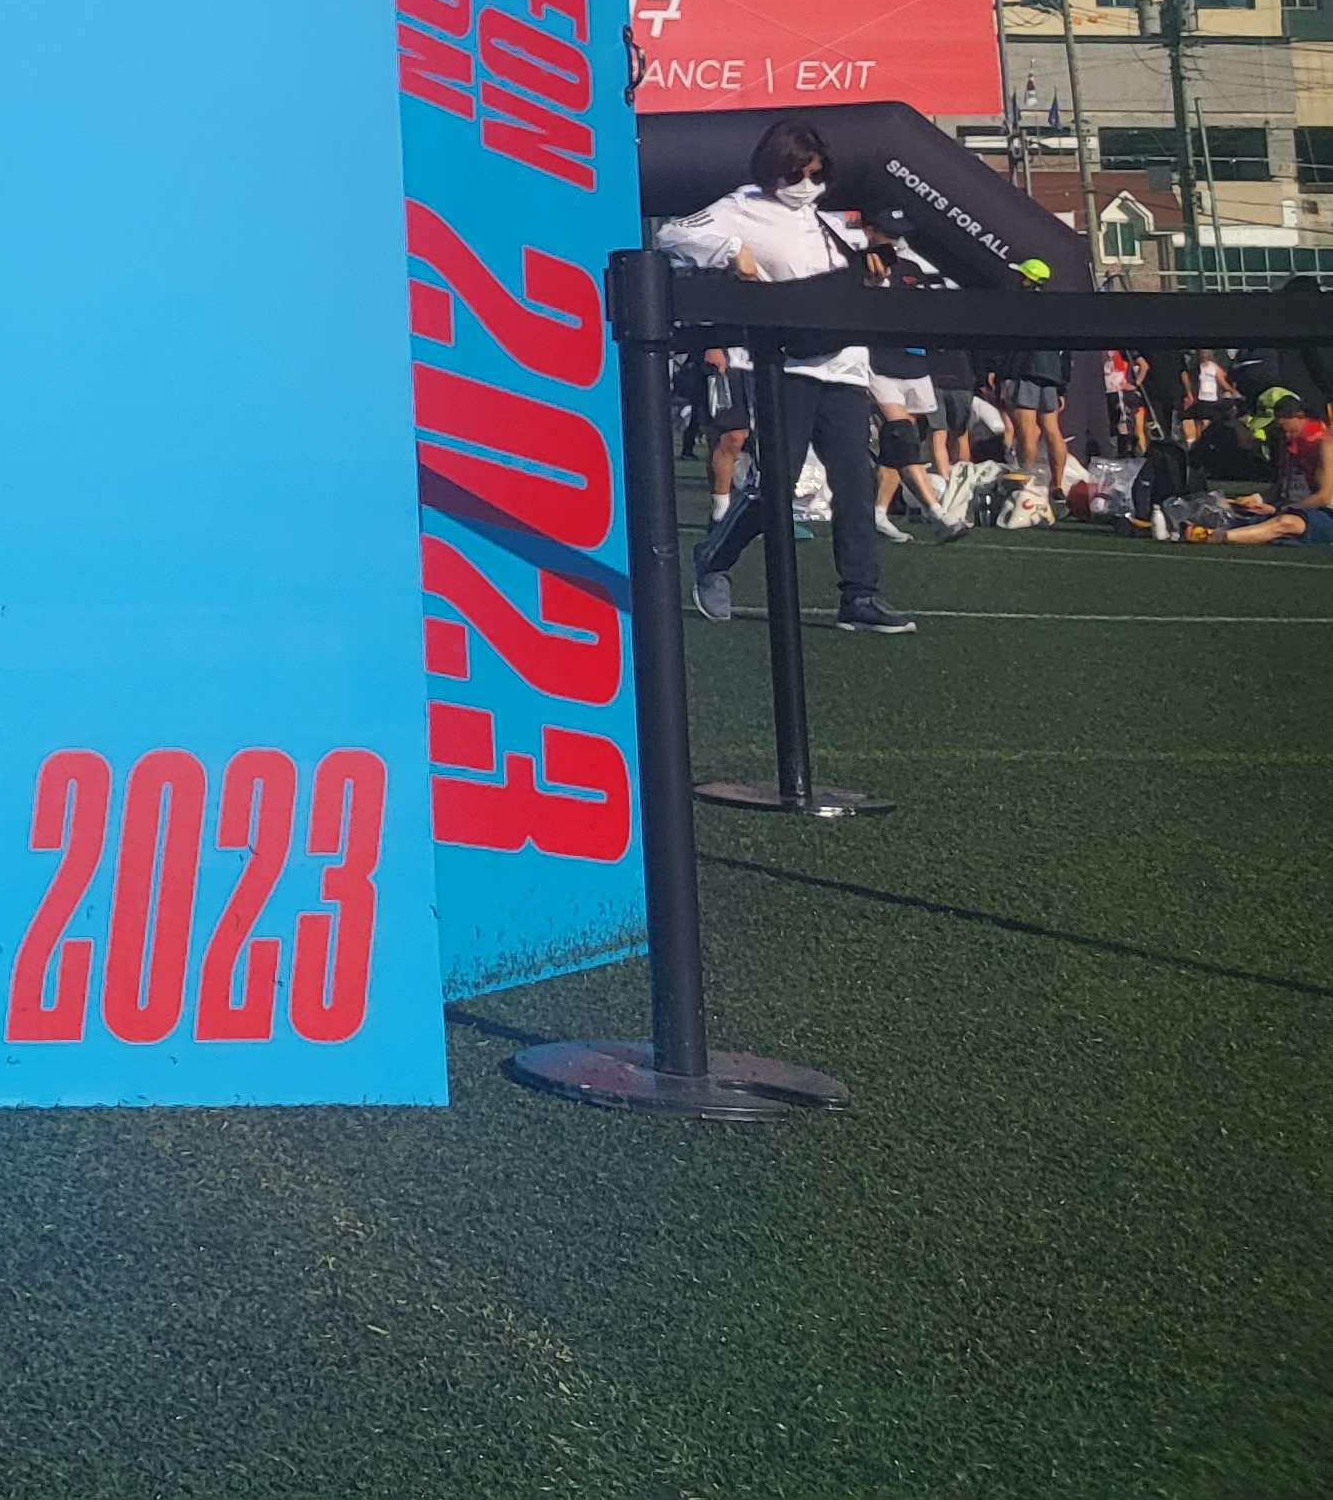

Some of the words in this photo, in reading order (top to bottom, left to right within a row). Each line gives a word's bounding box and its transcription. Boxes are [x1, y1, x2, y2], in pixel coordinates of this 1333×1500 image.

[639, 59, 746, 90] ANCE
[796, 60, 877, 91] EXIT
[885, 159, 949, 211] SPORTS
[946, 206, 982, 237] FOR
[978, 233, 1010, 260] ALL
[405, 198, 632, 863] 2023
[4, 747, 387, 1045] 2023
